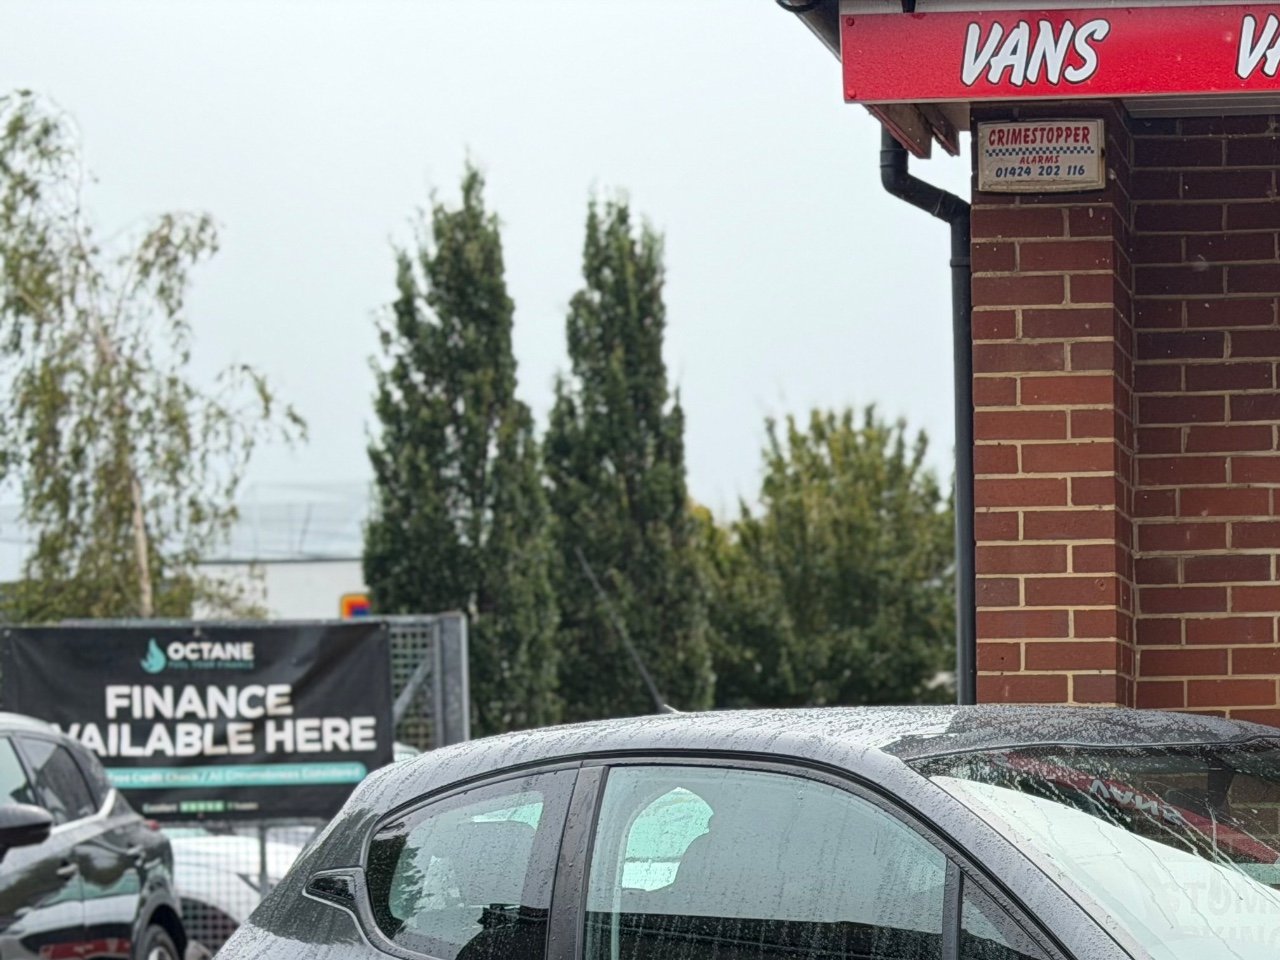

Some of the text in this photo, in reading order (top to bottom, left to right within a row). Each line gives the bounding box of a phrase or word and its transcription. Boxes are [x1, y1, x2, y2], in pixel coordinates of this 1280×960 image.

[961, 18, 1110, 87] VANS
[988, 126, 1091, 146] CRIMESTOPPER
[1019, 155, 1060, 165] ALARMS
[995, 165, 1085, 178] 01424 202 116
[167, 641, 255, 661] OCTANE
[105, 684, 294, 719] FINANCE
[50, 716, 377, 757] VAILABLE HERE
